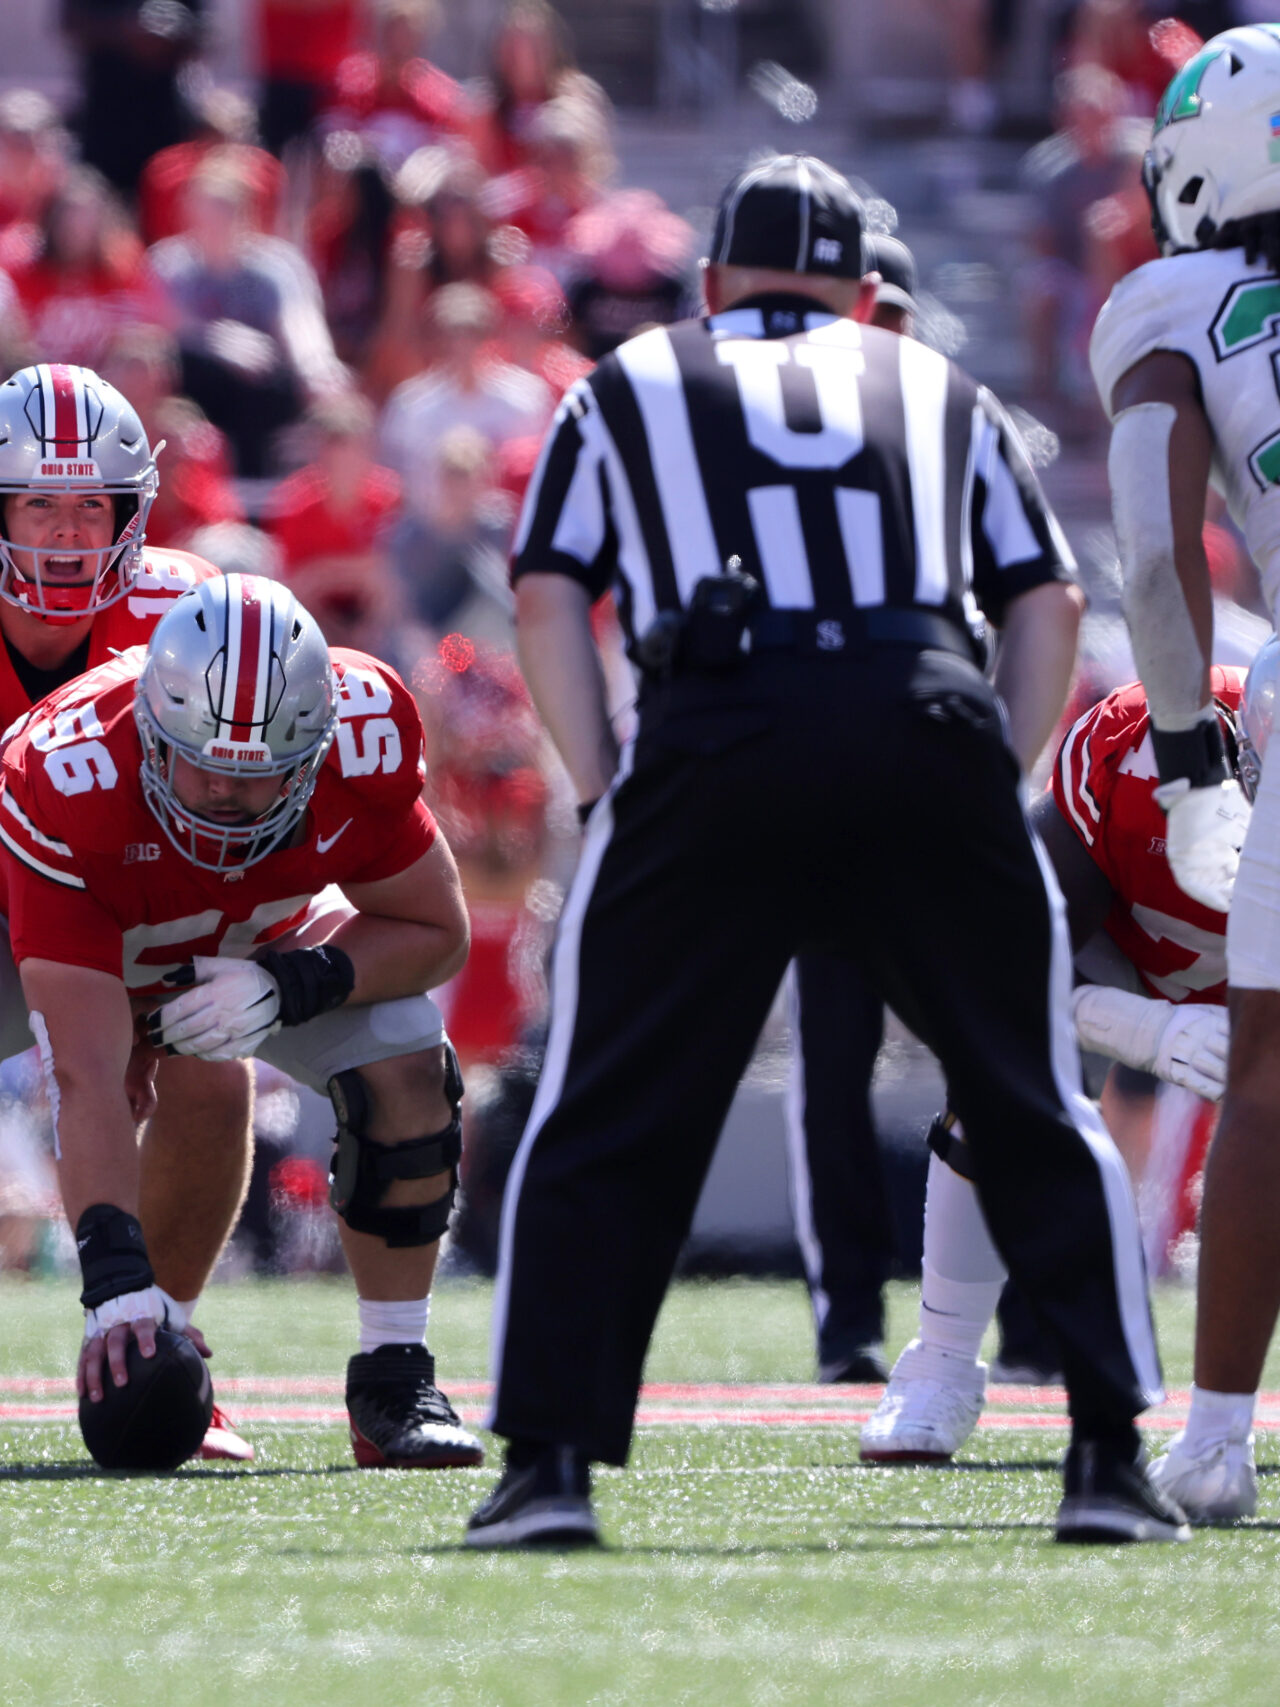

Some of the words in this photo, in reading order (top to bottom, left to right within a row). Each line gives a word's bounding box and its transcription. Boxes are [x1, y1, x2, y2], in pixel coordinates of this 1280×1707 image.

[715, 340, 866, 471] U
[41, 464, 64, 475] OHIO
[67, 464, 94, 476] STATE
[28, 700, 119, 798] 56
[211, 746, 235, 760] OHIO
[237, 750, 265, 762] STATE
[331, 667, 403, 779] 56
